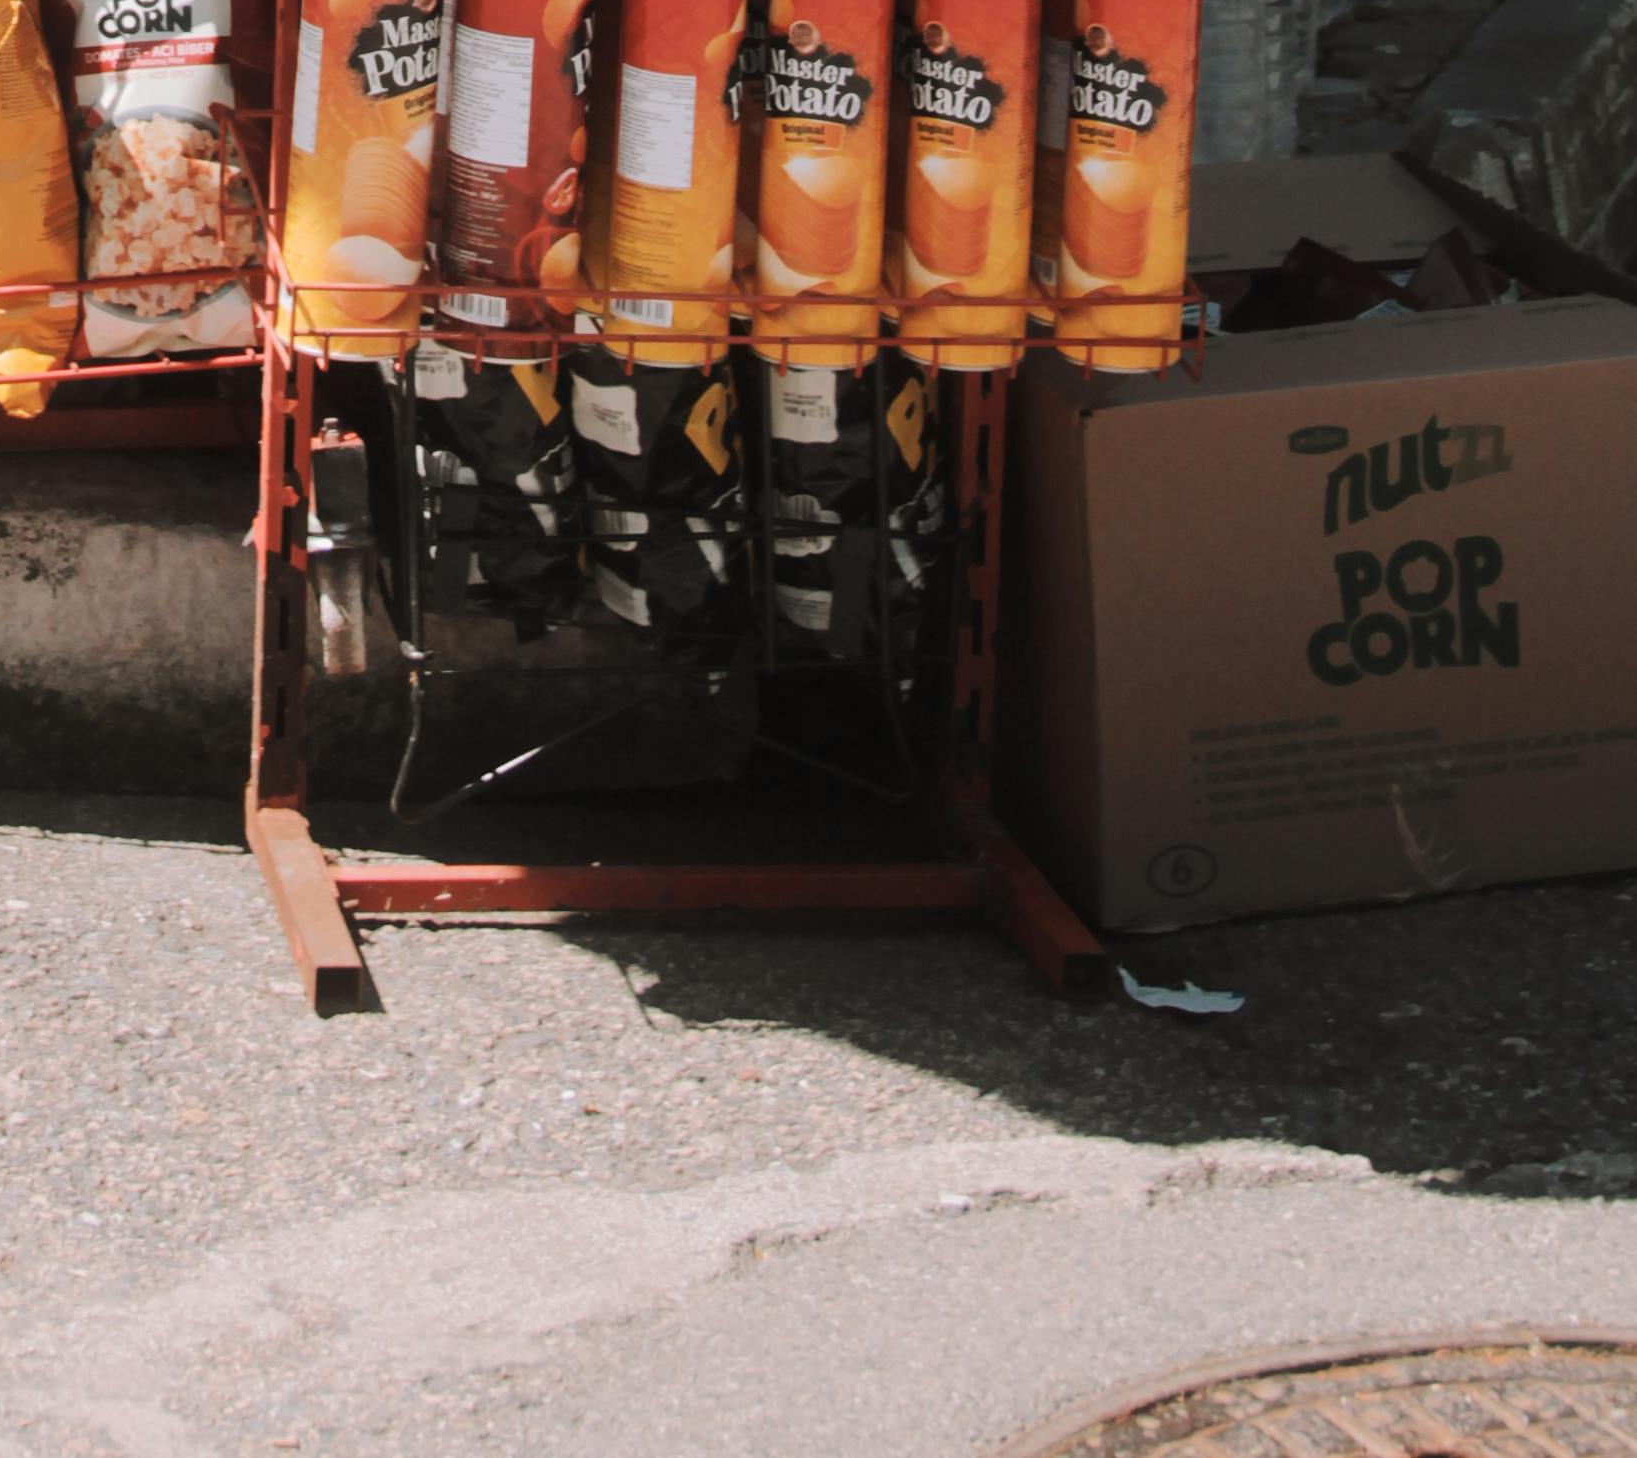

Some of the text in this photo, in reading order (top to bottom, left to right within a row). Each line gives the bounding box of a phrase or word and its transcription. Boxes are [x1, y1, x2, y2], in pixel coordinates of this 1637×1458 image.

[97, 5, 193, 39] CORN
[176, 41, 215, 57] BİBER
[771, 50, 854, 86] Master
[765, 75, 862, 121] Potato
[1334, 533, 1504, 625] POP
[1306, 601, 1521, 688] CORN
